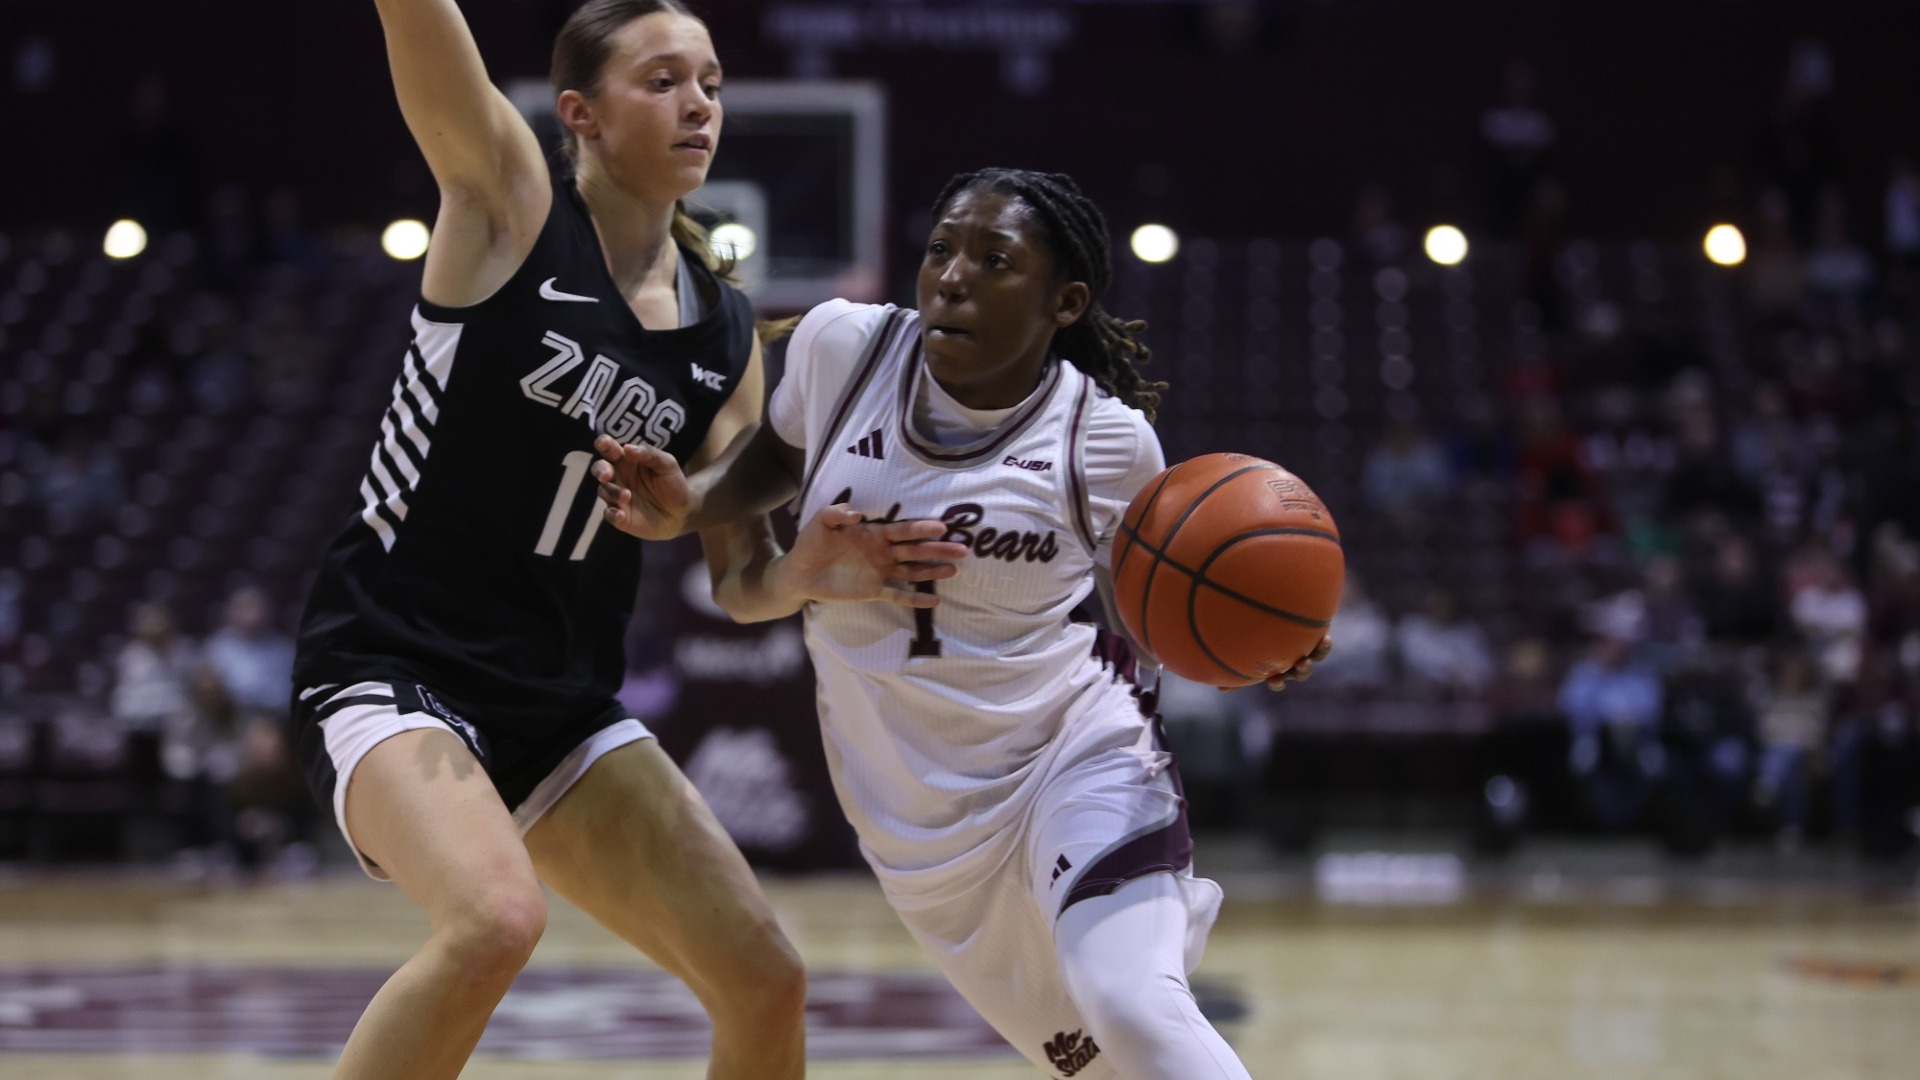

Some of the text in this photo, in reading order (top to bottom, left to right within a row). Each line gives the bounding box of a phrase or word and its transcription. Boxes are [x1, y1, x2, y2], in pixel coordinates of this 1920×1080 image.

[519, 330, 686, 450] ZAGS
[690, 362, 727, 391] WCC
[940, 503, 1059, 563] Bears
